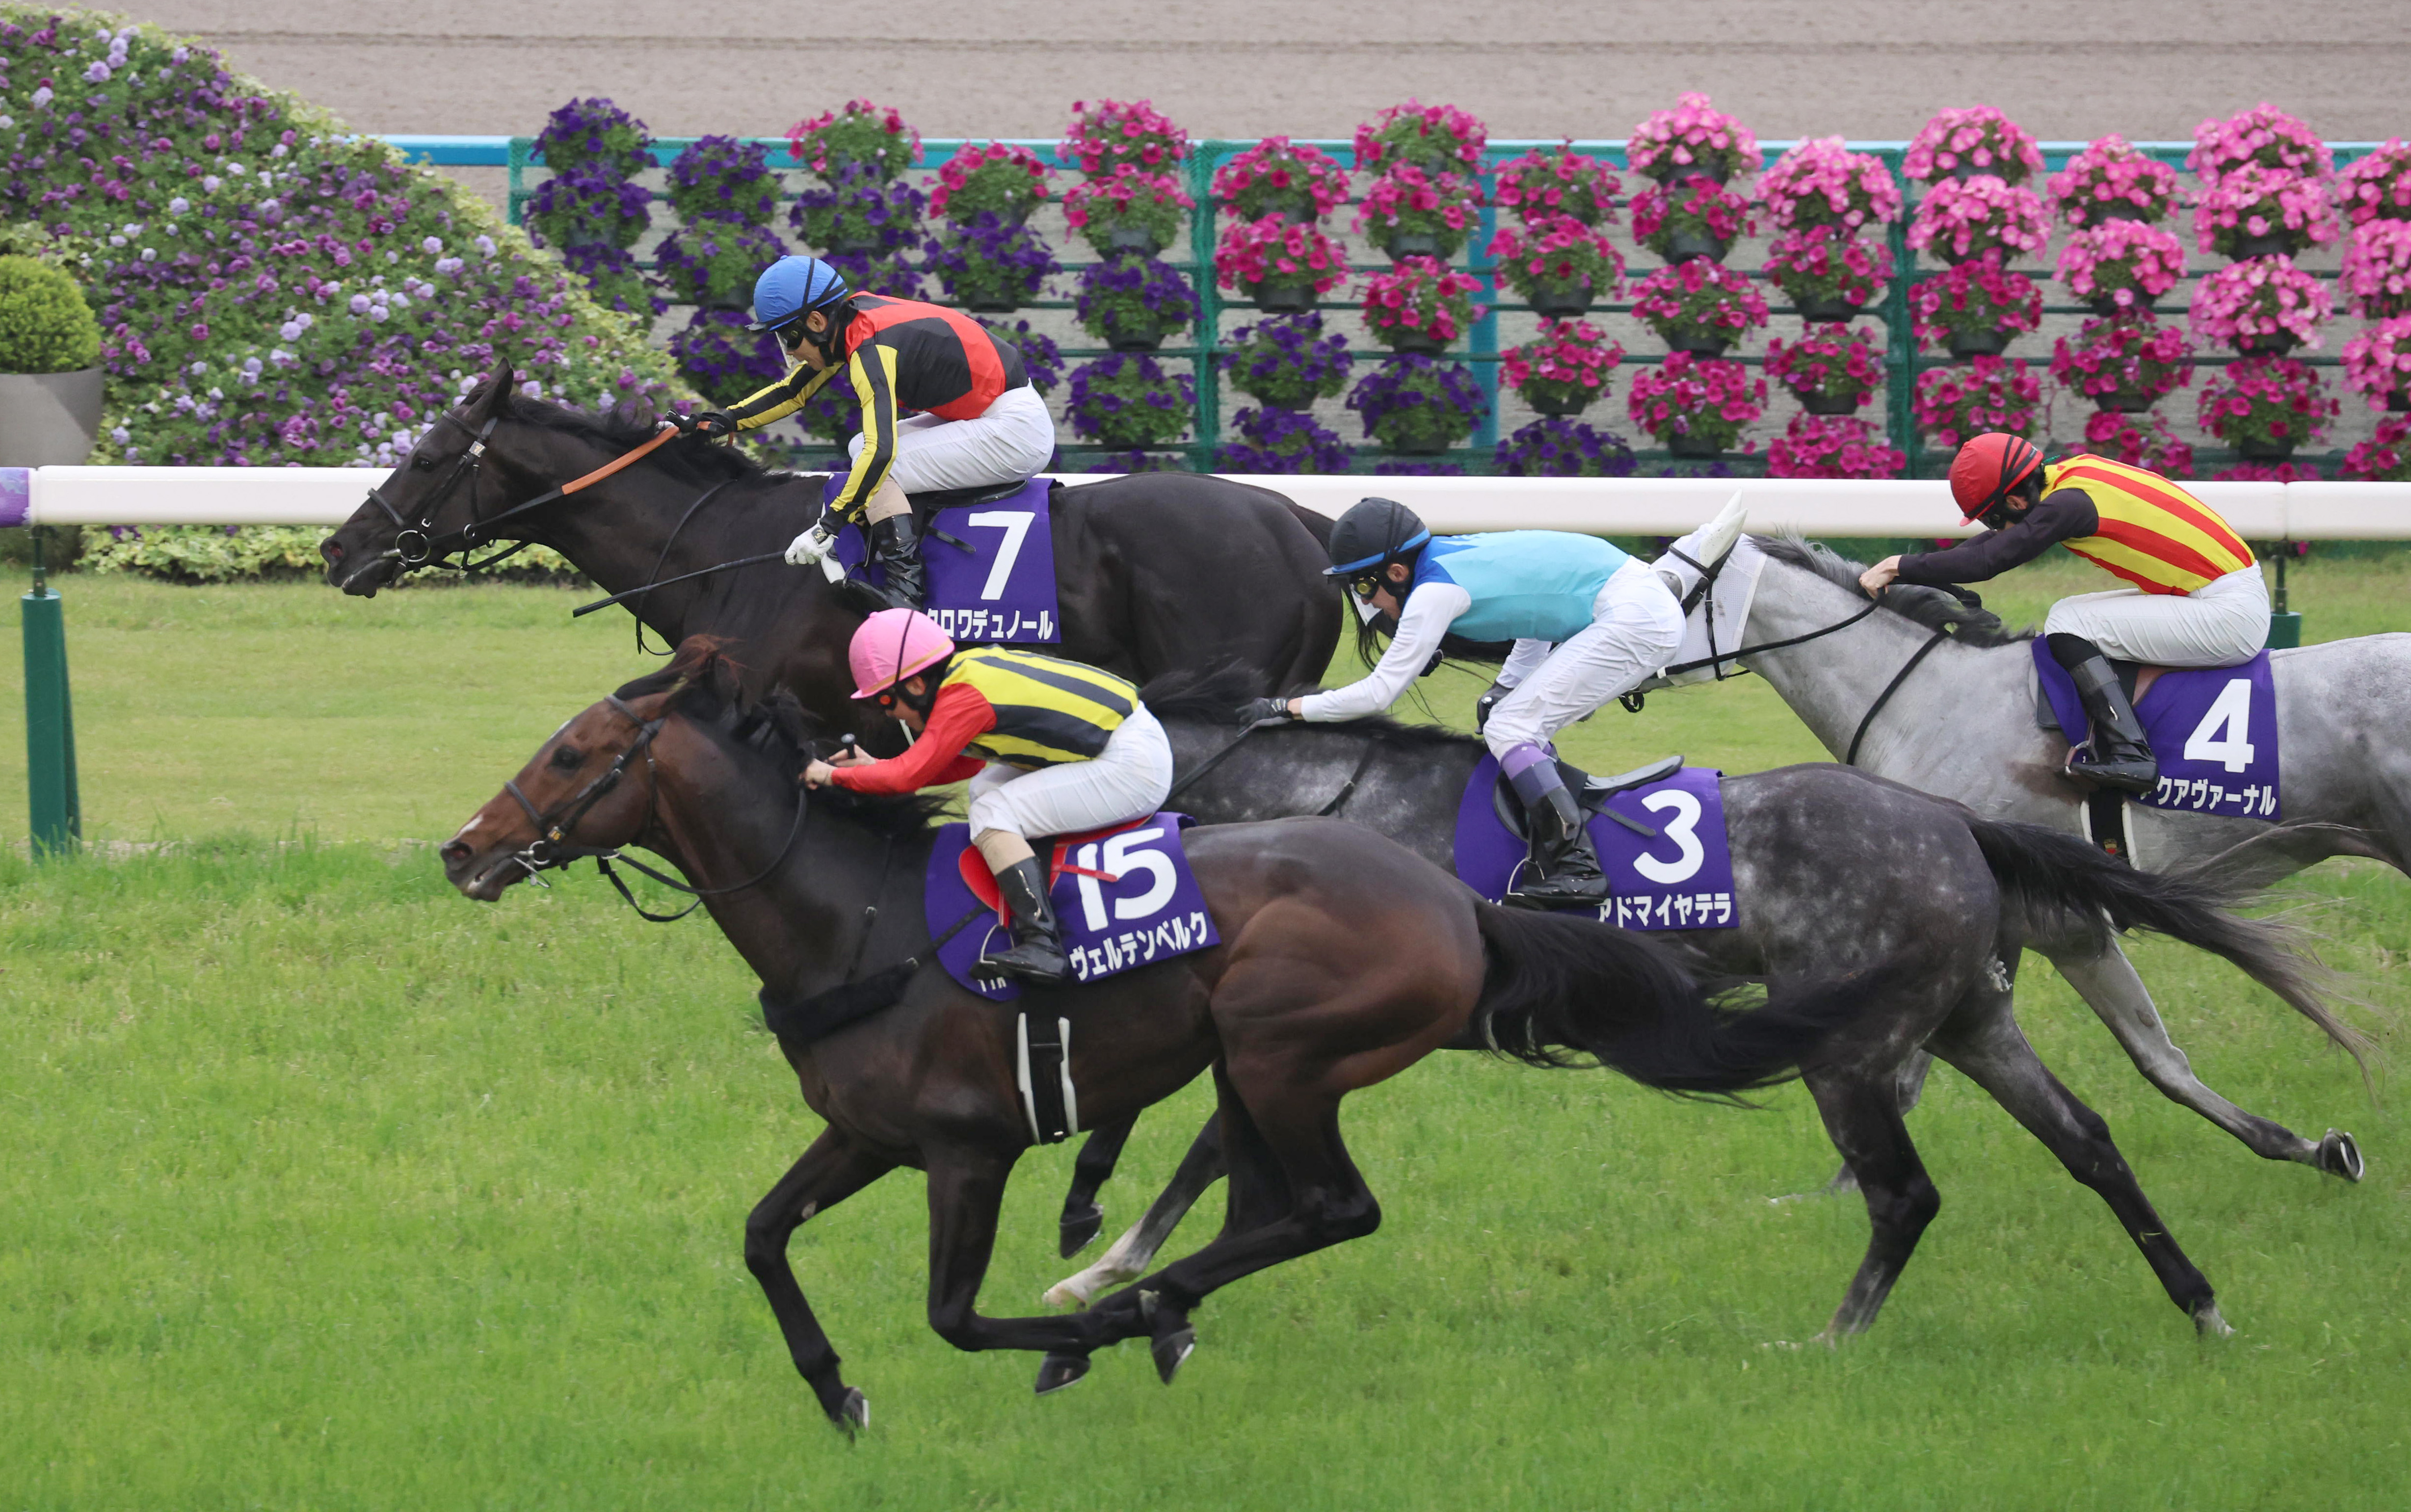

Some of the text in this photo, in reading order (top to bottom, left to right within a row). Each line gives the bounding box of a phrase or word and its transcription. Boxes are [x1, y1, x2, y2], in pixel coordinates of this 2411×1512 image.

[968, 511, 1036, 600] 7
[2183, 678, 2254, 773] 4
[1633, 789, 1704, 884] 3
[2140, 776, 2277, 816] クアヴァーナル
[1077, 828, 1177, 932] 15
[1595, 893, 1731, 928] アドマイヤテラ
[1069, 912, 1207, 981] ヴェルテンベルク
